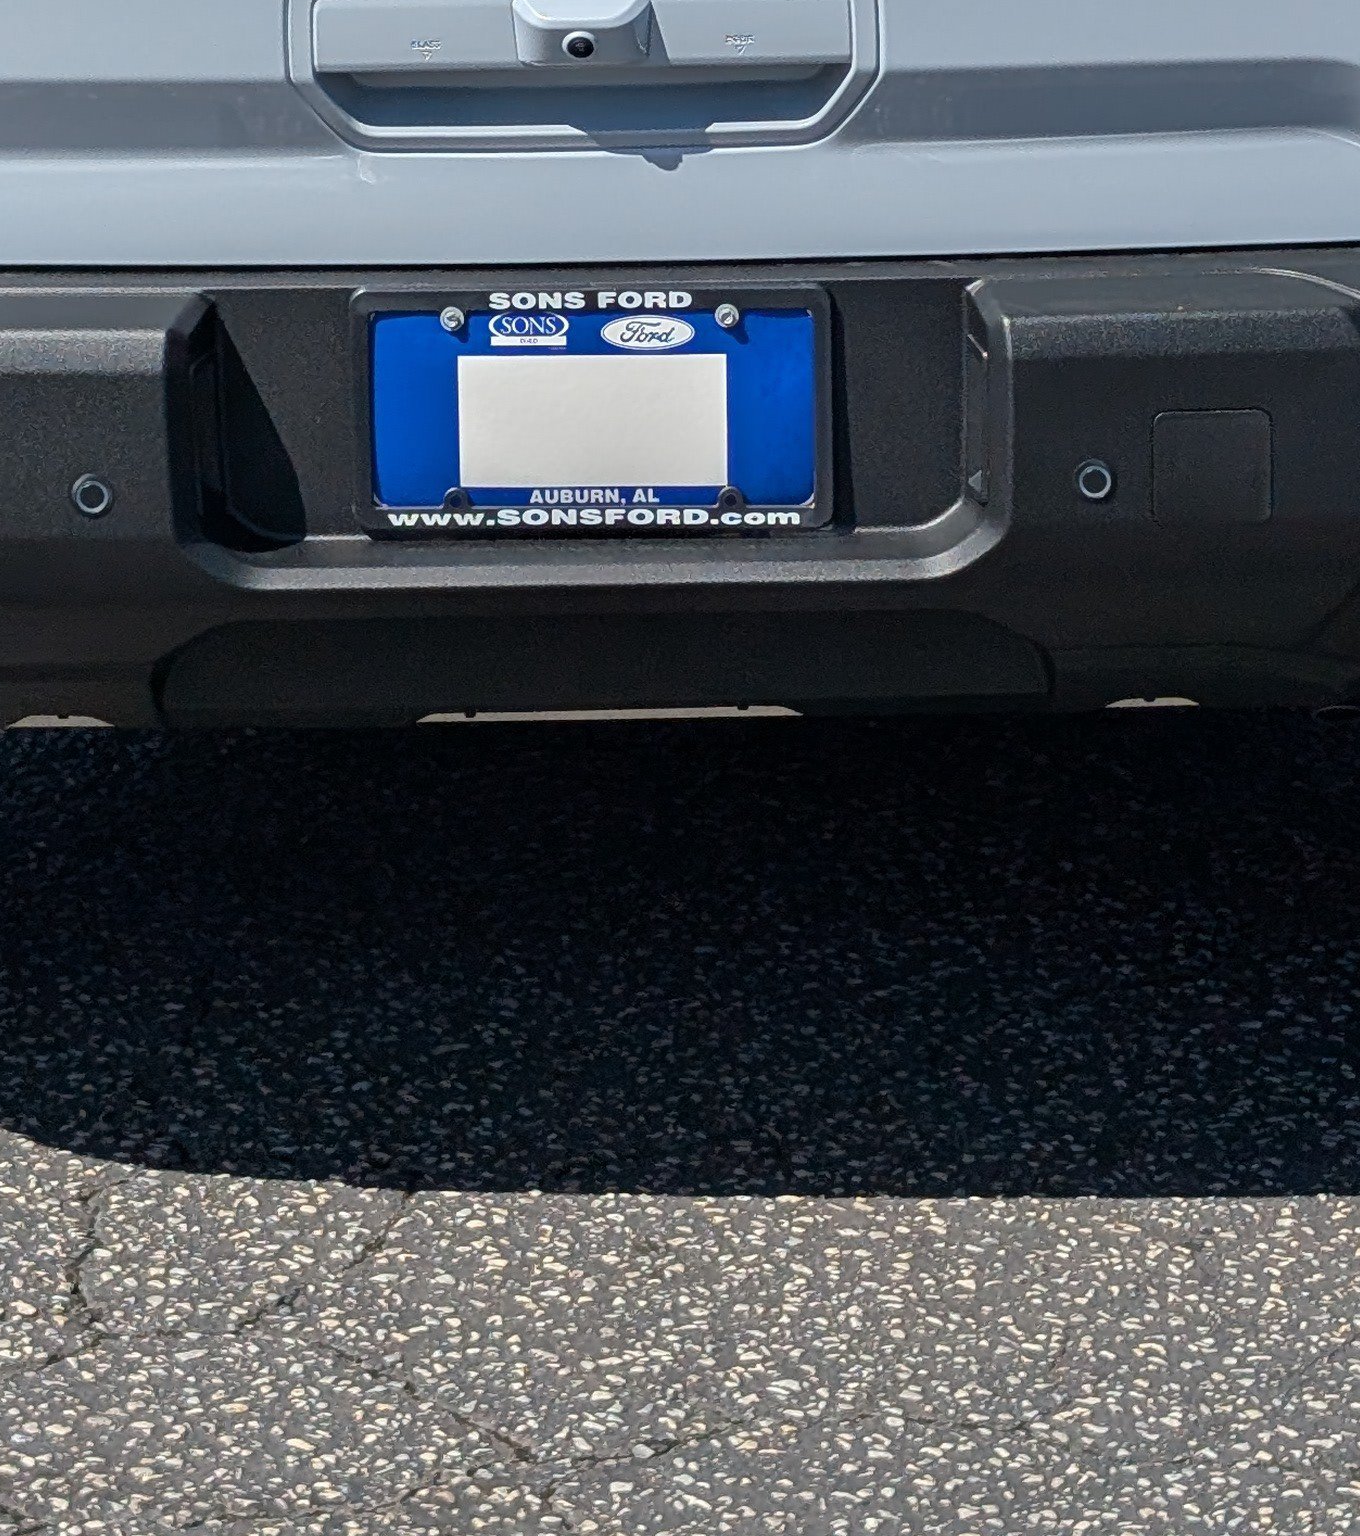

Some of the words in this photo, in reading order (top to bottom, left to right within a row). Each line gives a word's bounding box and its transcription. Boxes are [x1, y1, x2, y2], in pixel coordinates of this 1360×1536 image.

[489, 292, 585, 310] SONS
[597, 291, 693, 310] FORD
[500, 316, 557, 335] SONS
[619, 321, 675, 344] Ford
[529, 489, 627, 505] AUBURN,
[632, 489, 660, 503] AL
[388, 508, 800, 526] www.SONSFORD.com
